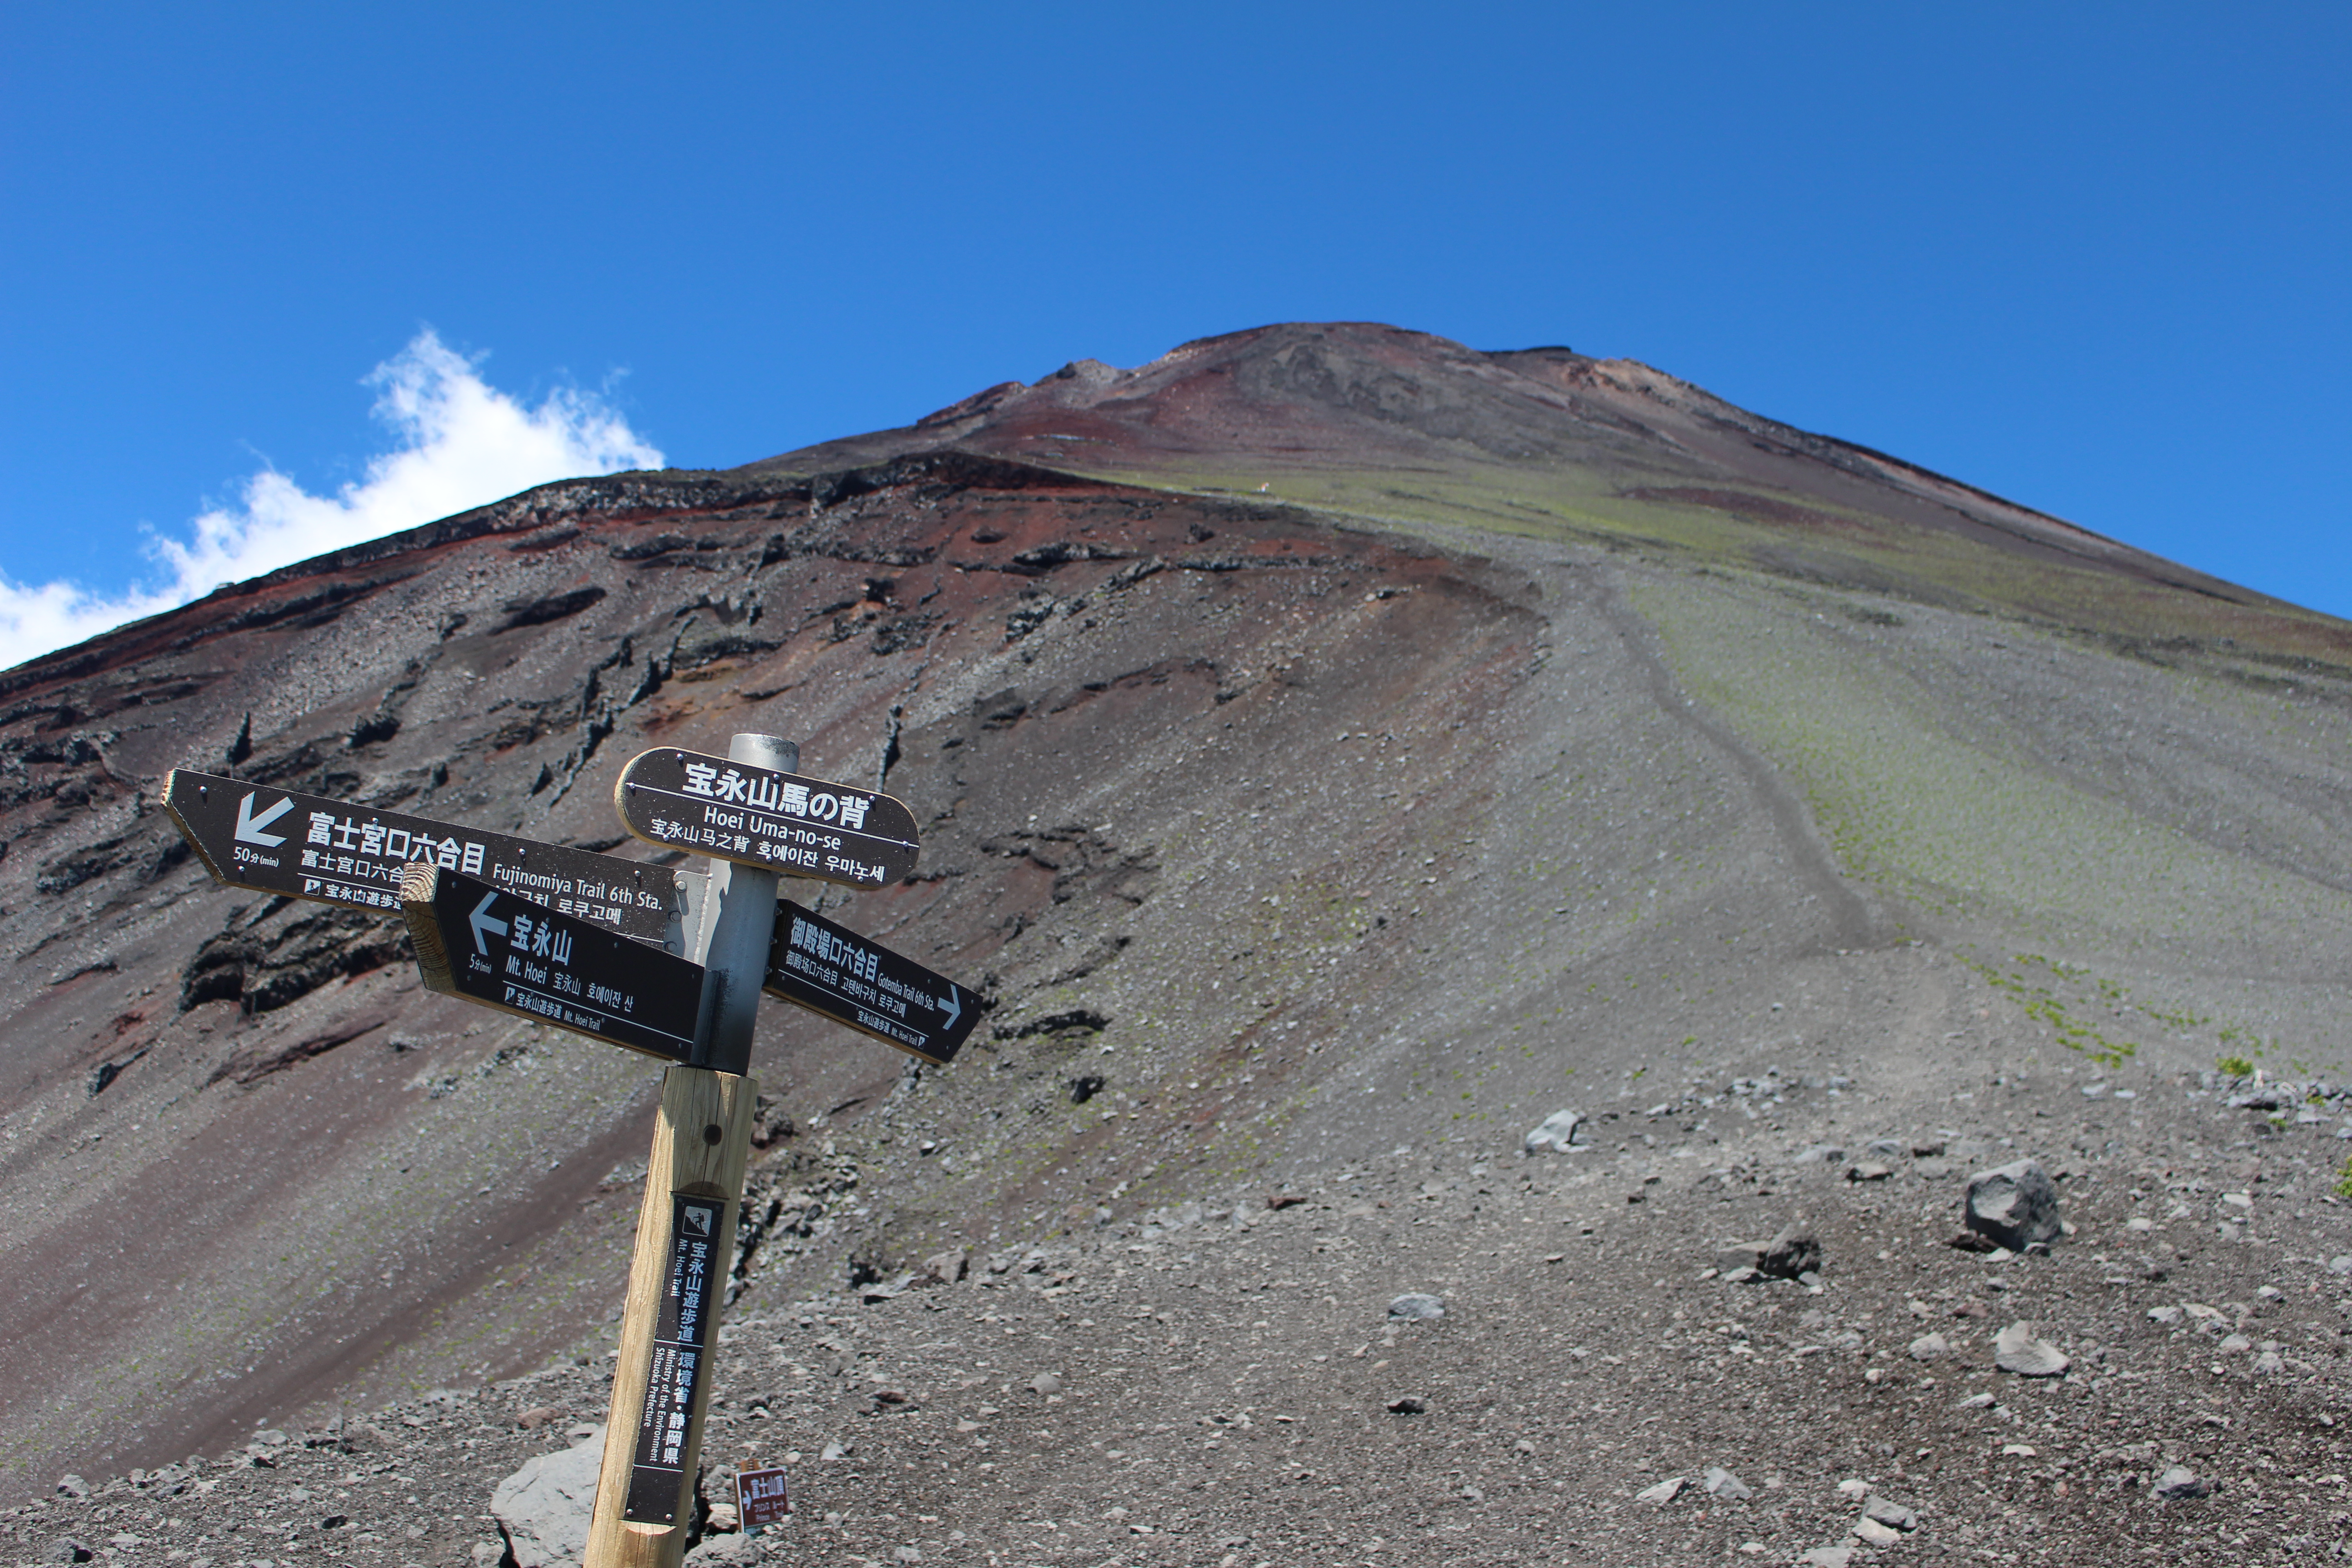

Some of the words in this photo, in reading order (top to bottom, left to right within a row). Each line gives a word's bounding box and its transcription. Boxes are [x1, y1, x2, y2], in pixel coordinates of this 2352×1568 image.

[682, 763, 870, 829] 宝永山馬の背
[306, 812, 486, 875] 富士宮口六合目
[650, 818, 751, 853] 宝永山马之背
[756, 840, 818, 867] 호에이잔
[824, 855, 885, 882] 우마노세
[704, 806, 744, 830] Hoei
[749, 815, 842, 851] Uma-no-se
[493, 863, 572, 895] Fujinomiya
[576, 879, 606, 900] Trail
[609, 886, 632, 905] 6th
[637, 891, 663, 911] Sta.
[557, 898, 622, 926] 로쿠고메
[510, 914, 572, 965] 宝永山
[505, 955, 521, 976] Mt.
[524, 961, 548, 984] Hoei
[553, 972, 581, 996] 宝永山
[587, 983, 621, 1009] 호에이잔
[624, 996, 633, 1013] 산
[786, 950, 838, 986] 御殿场口六合目
[841, 976, 877, 1004] 고텐바구치
[878, 994, 906, 1018] 로쿠고메
[790, 916, 878, 982] 御殿場口六合目
[878, 973, 902, 996] Gotemba
[903, 984, 915, 1002] Trail
[915, 990, 925, 1008] 6th
[926, 995, 934, 1011] Sta.
[516, 992, 562, 1019] 宝永山遊歩道
[564, 1010, 573, 1023] Mt.
[575, 1014, 588, 1027] Hoei
[589, 1017, 601, 1031] Trail
[857, 1010, 890, 1034] 宝永山遊歩道
[899, 1029, 908, 1042] Hoei
[909, 1035, 917, 1046] Trail
[674, 1256, 685, 1276] Hoei
[678, 1239, 688, 1252] Mt.
[671, 1278, 682, 1297] Trail
[677, 1242, 707, 1342] 宝永山遊歩道
[651, 1347, 665, 1384] Shizuoka
[662, 1349, 676, 1382] Ministry
[644, 1386, 659, 1427] Prefecture
[659, 1392, 669, 1408] the
[662, 1384, 669, 1394] of
[662, 1352, 696, 1465] 環境省・静岡県
[649, 1410, 666, 1462] Environment
